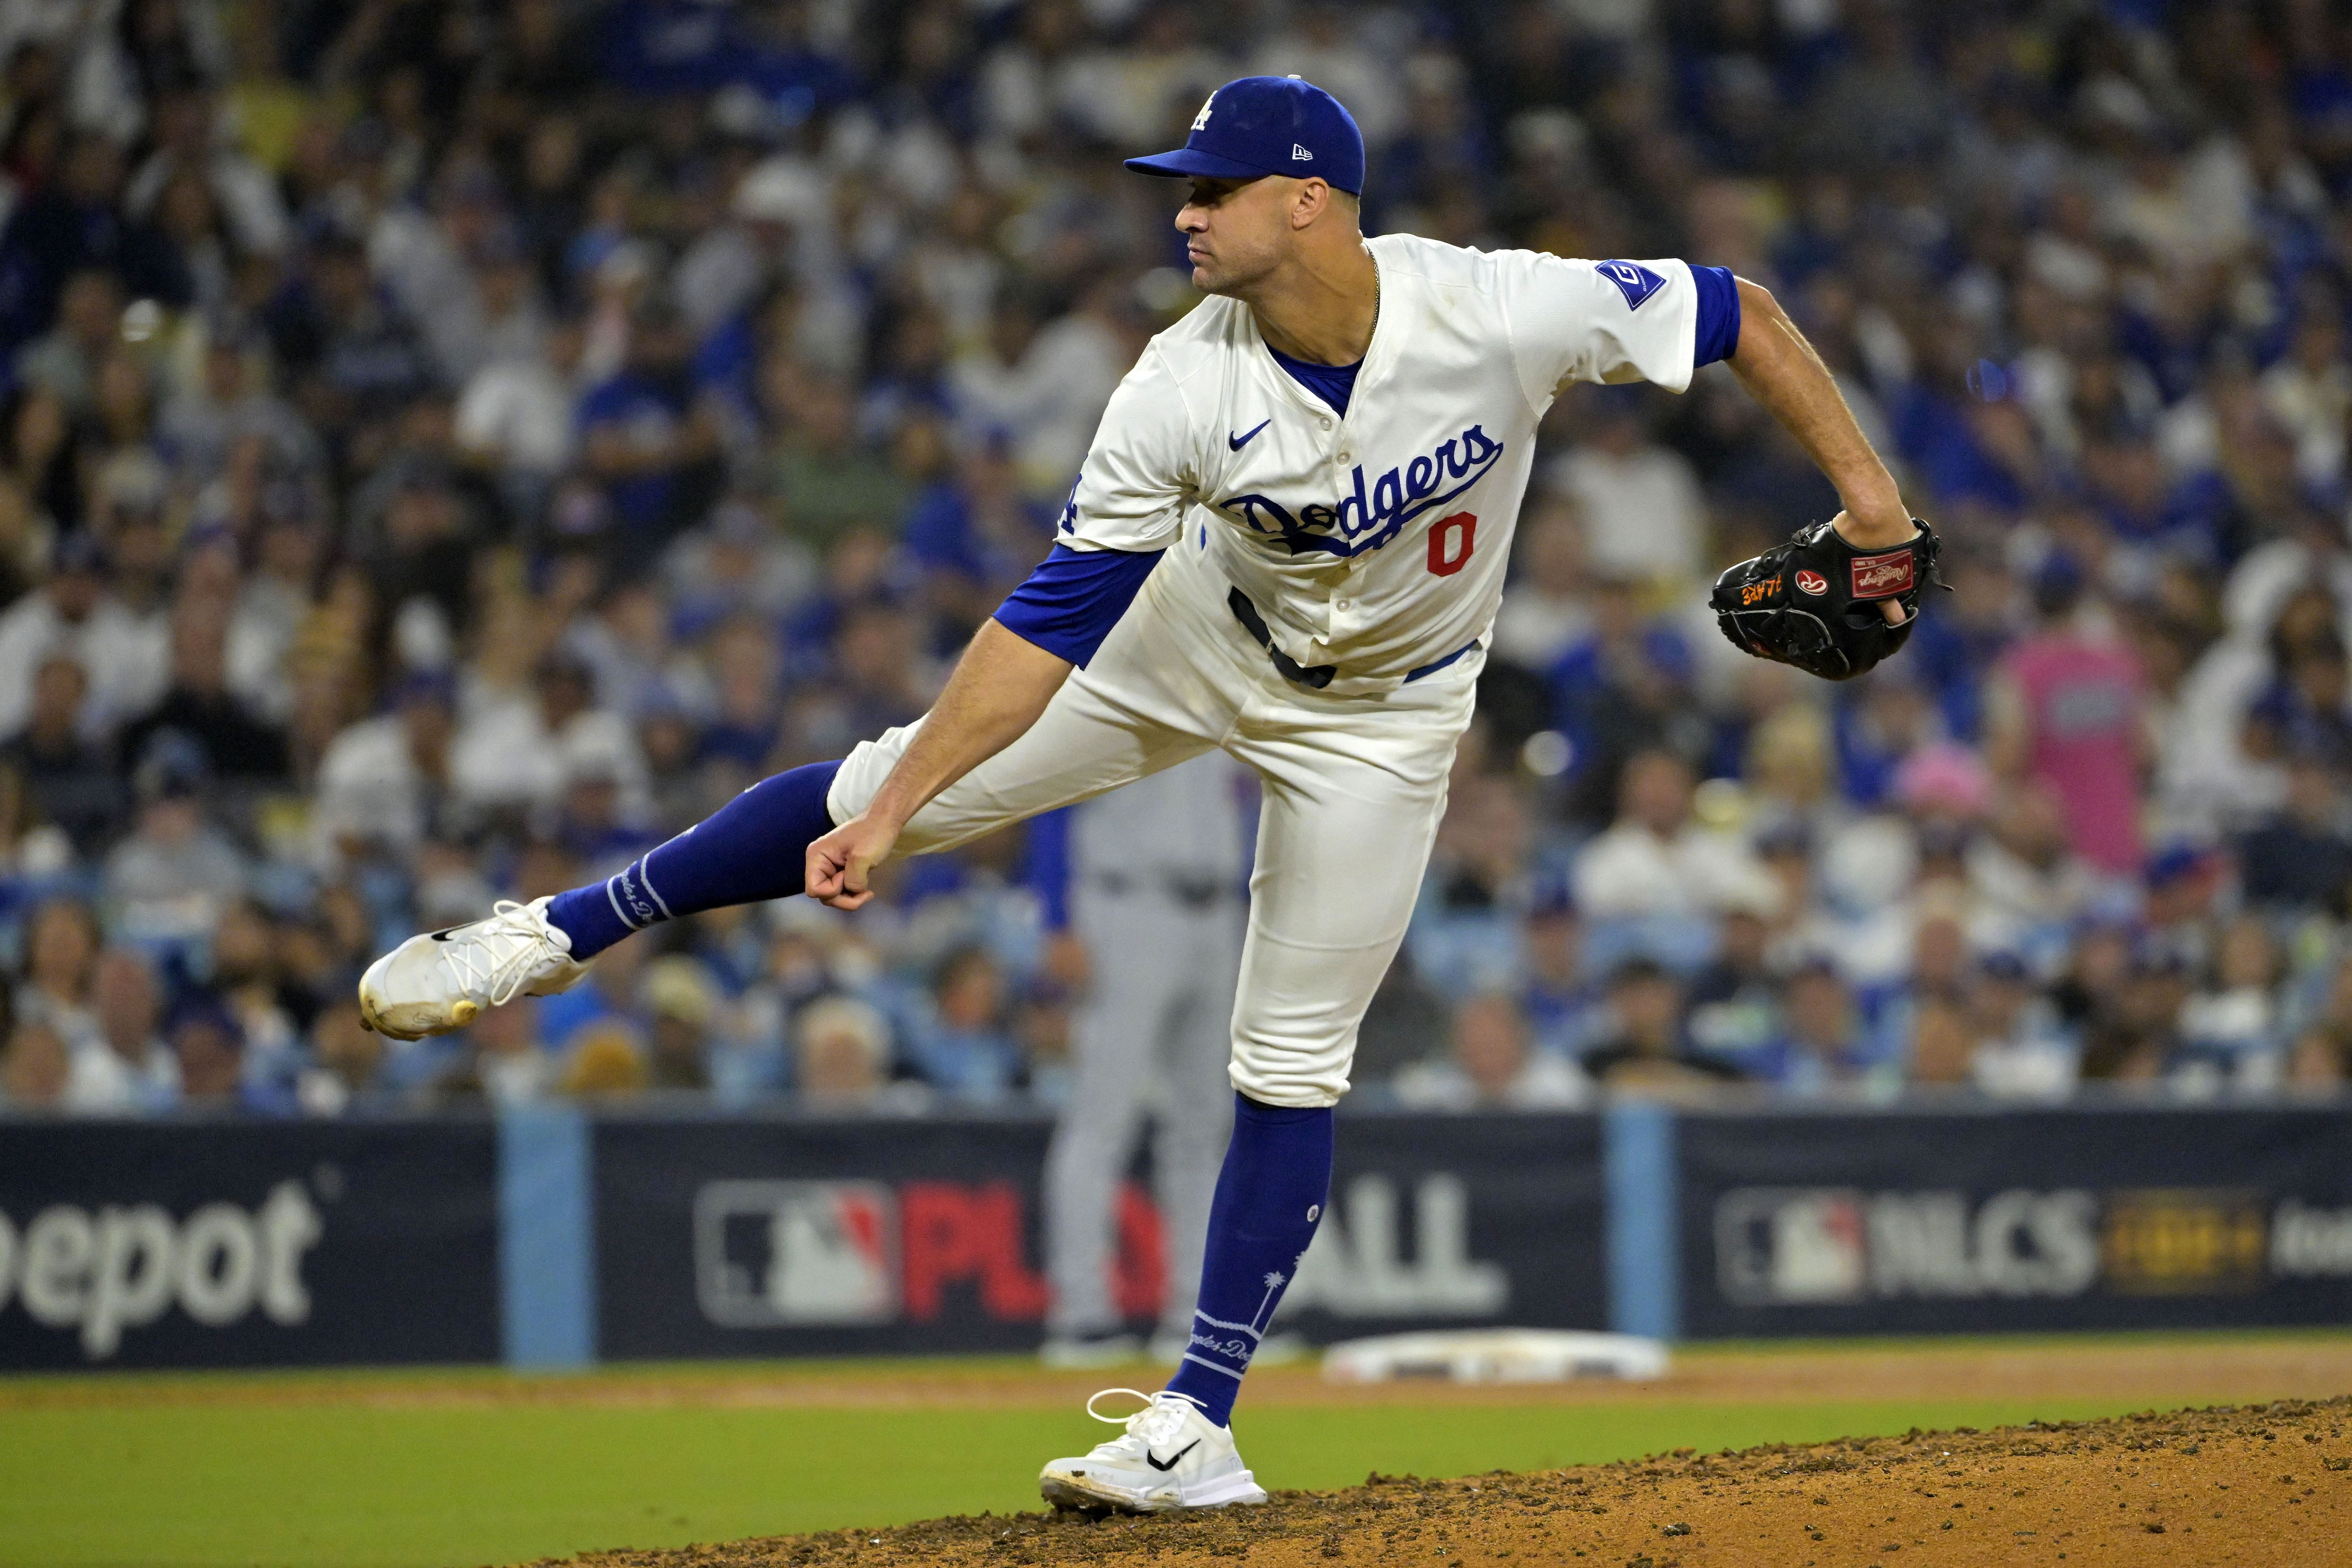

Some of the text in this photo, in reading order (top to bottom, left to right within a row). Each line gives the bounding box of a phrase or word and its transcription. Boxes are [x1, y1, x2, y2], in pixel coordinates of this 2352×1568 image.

[1219, 425, 1504, 558] Dodgers
[1427, 511, 1477, 577] 0
[1858, 564, 1909, 587] Rawlings
[0, 1180, 317, 1356] epot
